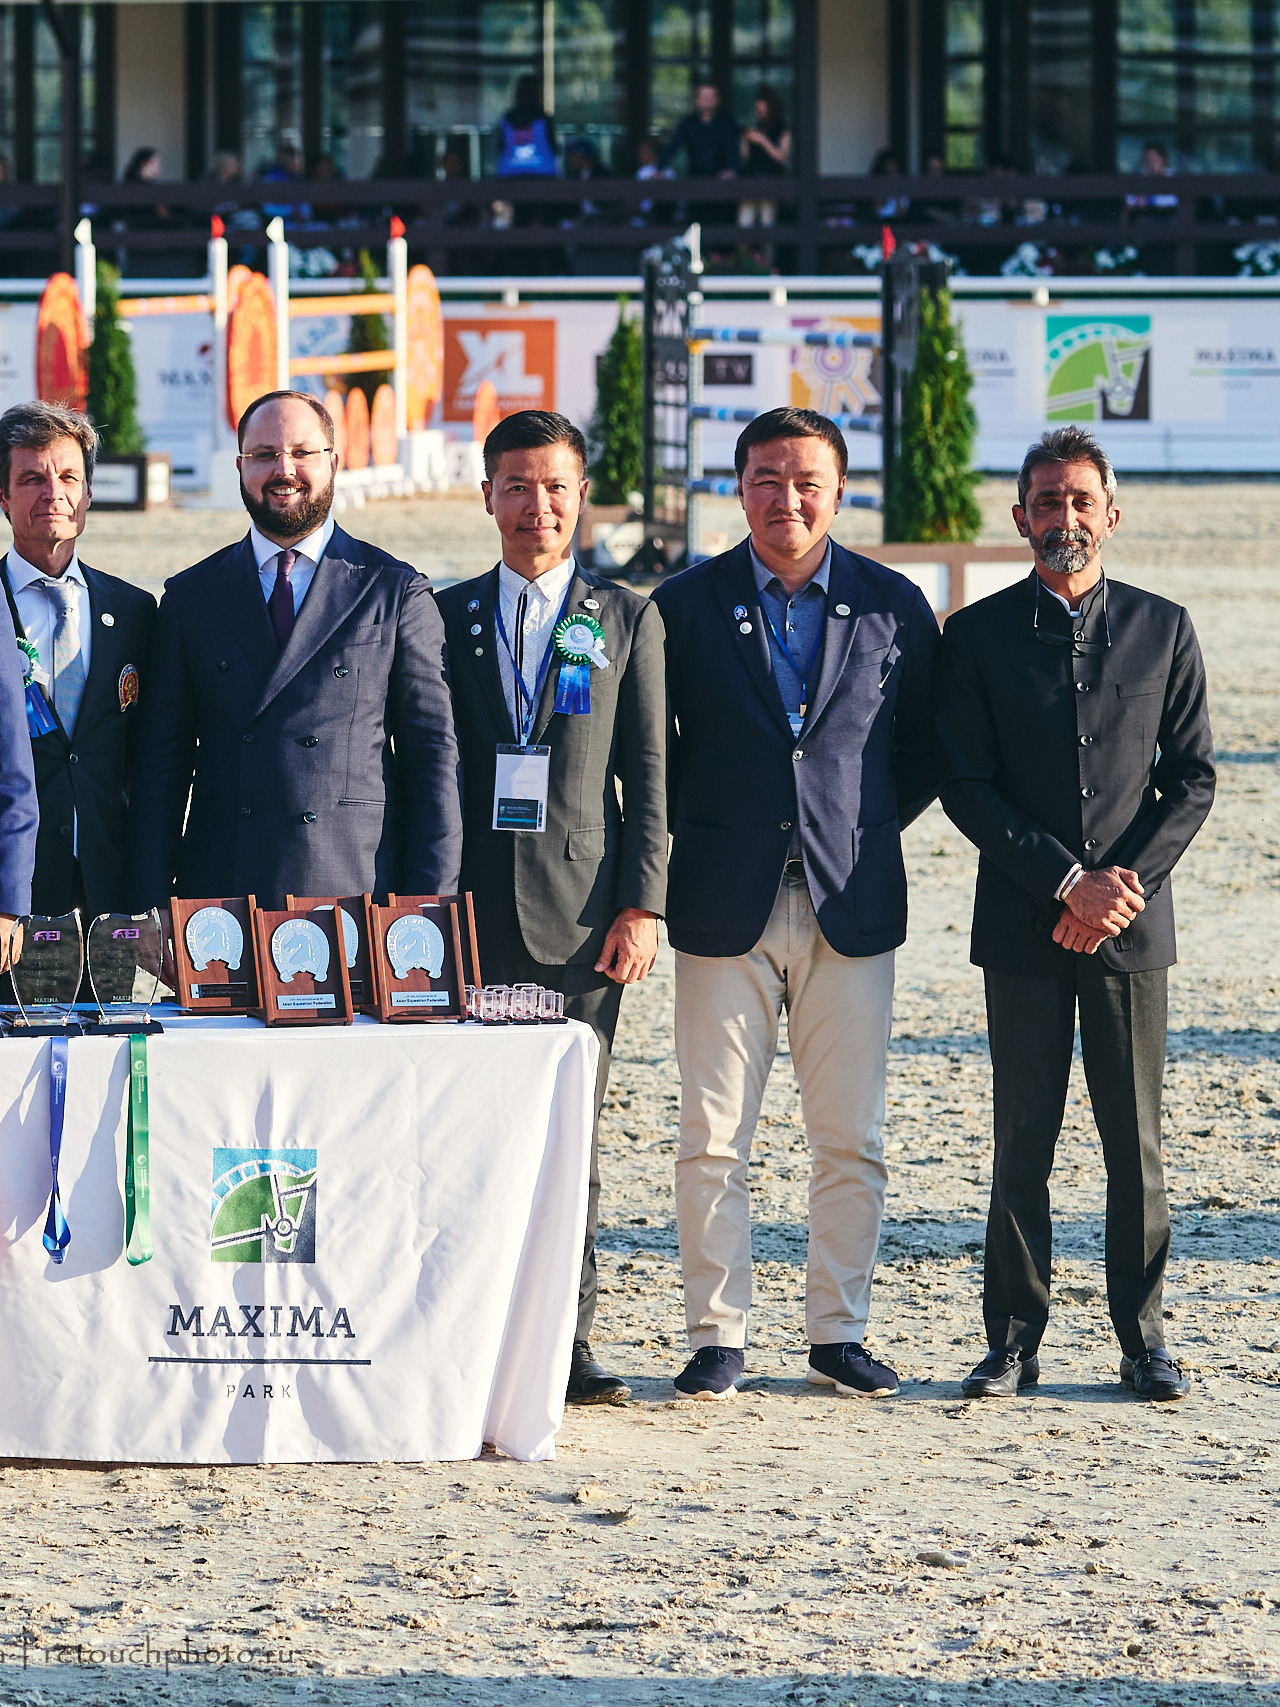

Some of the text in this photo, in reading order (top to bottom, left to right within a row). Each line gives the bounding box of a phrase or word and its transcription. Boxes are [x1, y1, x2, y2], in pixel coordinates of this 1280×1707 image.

[456, 330, 544, 396] XL
[166, 1304, 356, 1338] MAXIMA
[226, 1384, 291, 1399] PARK
